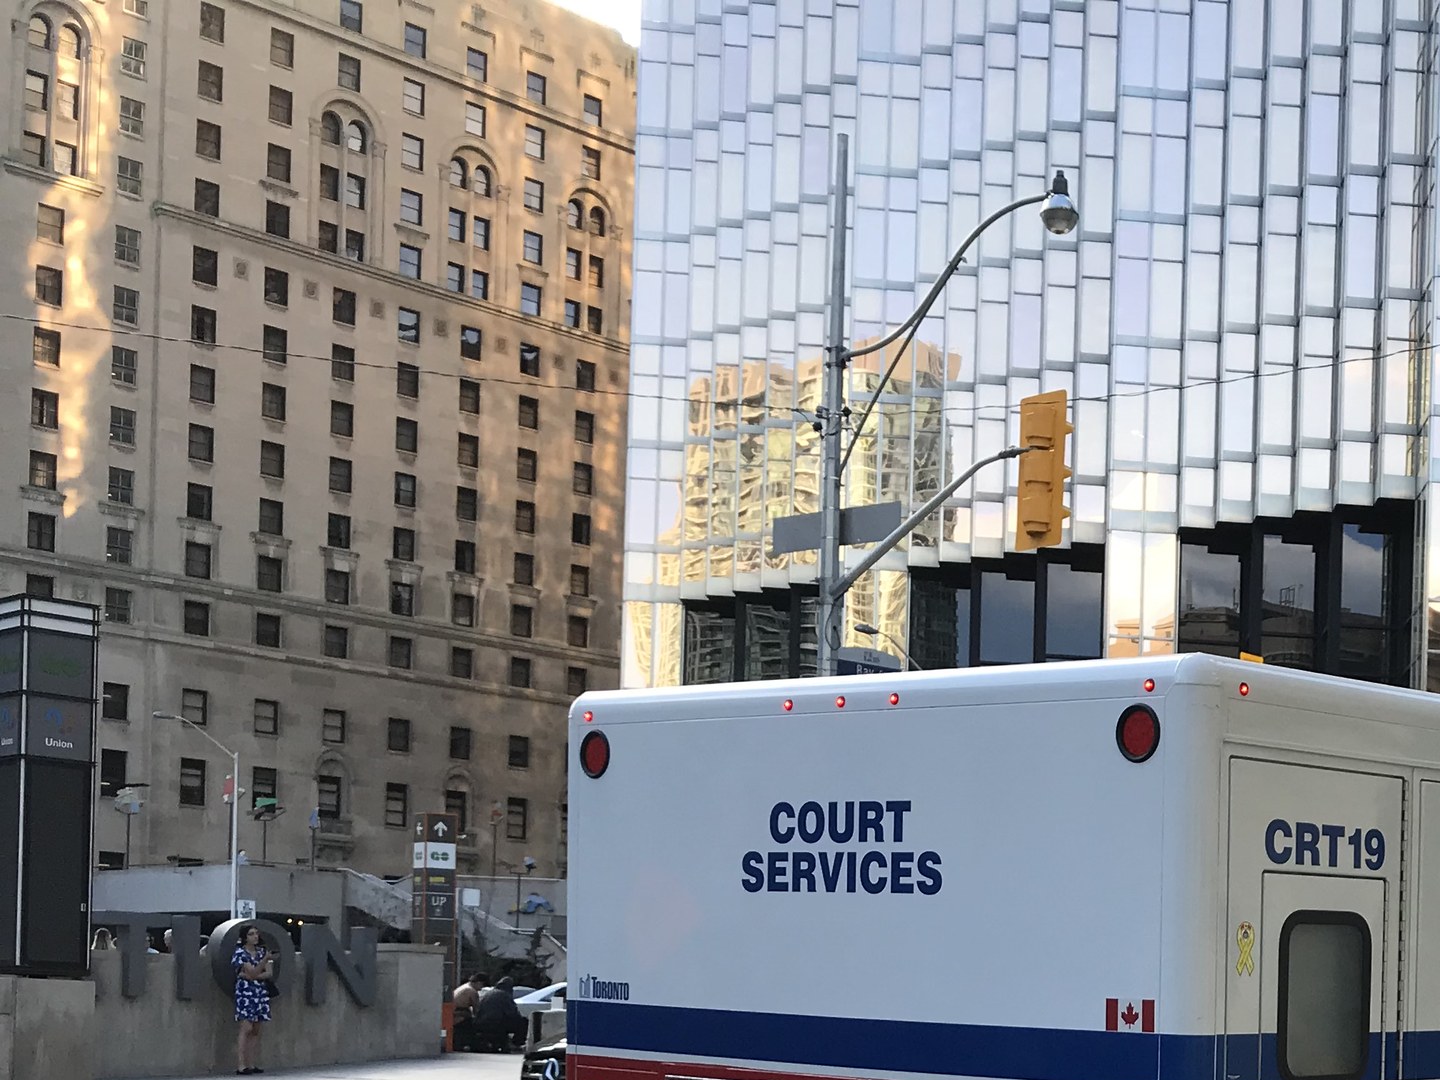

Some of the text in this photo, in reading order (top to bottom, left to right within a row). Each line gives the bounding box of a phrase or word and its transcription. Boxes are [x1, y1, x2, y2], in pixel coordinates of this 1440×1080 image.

[45, 737, 73, 748] Union
[769, 800, 911, 844] COURT
[741, 850, 943, 895] SERVICES
[431, 896, 447, 906] UP
[591, 976, 630, 1001] TORONTO
